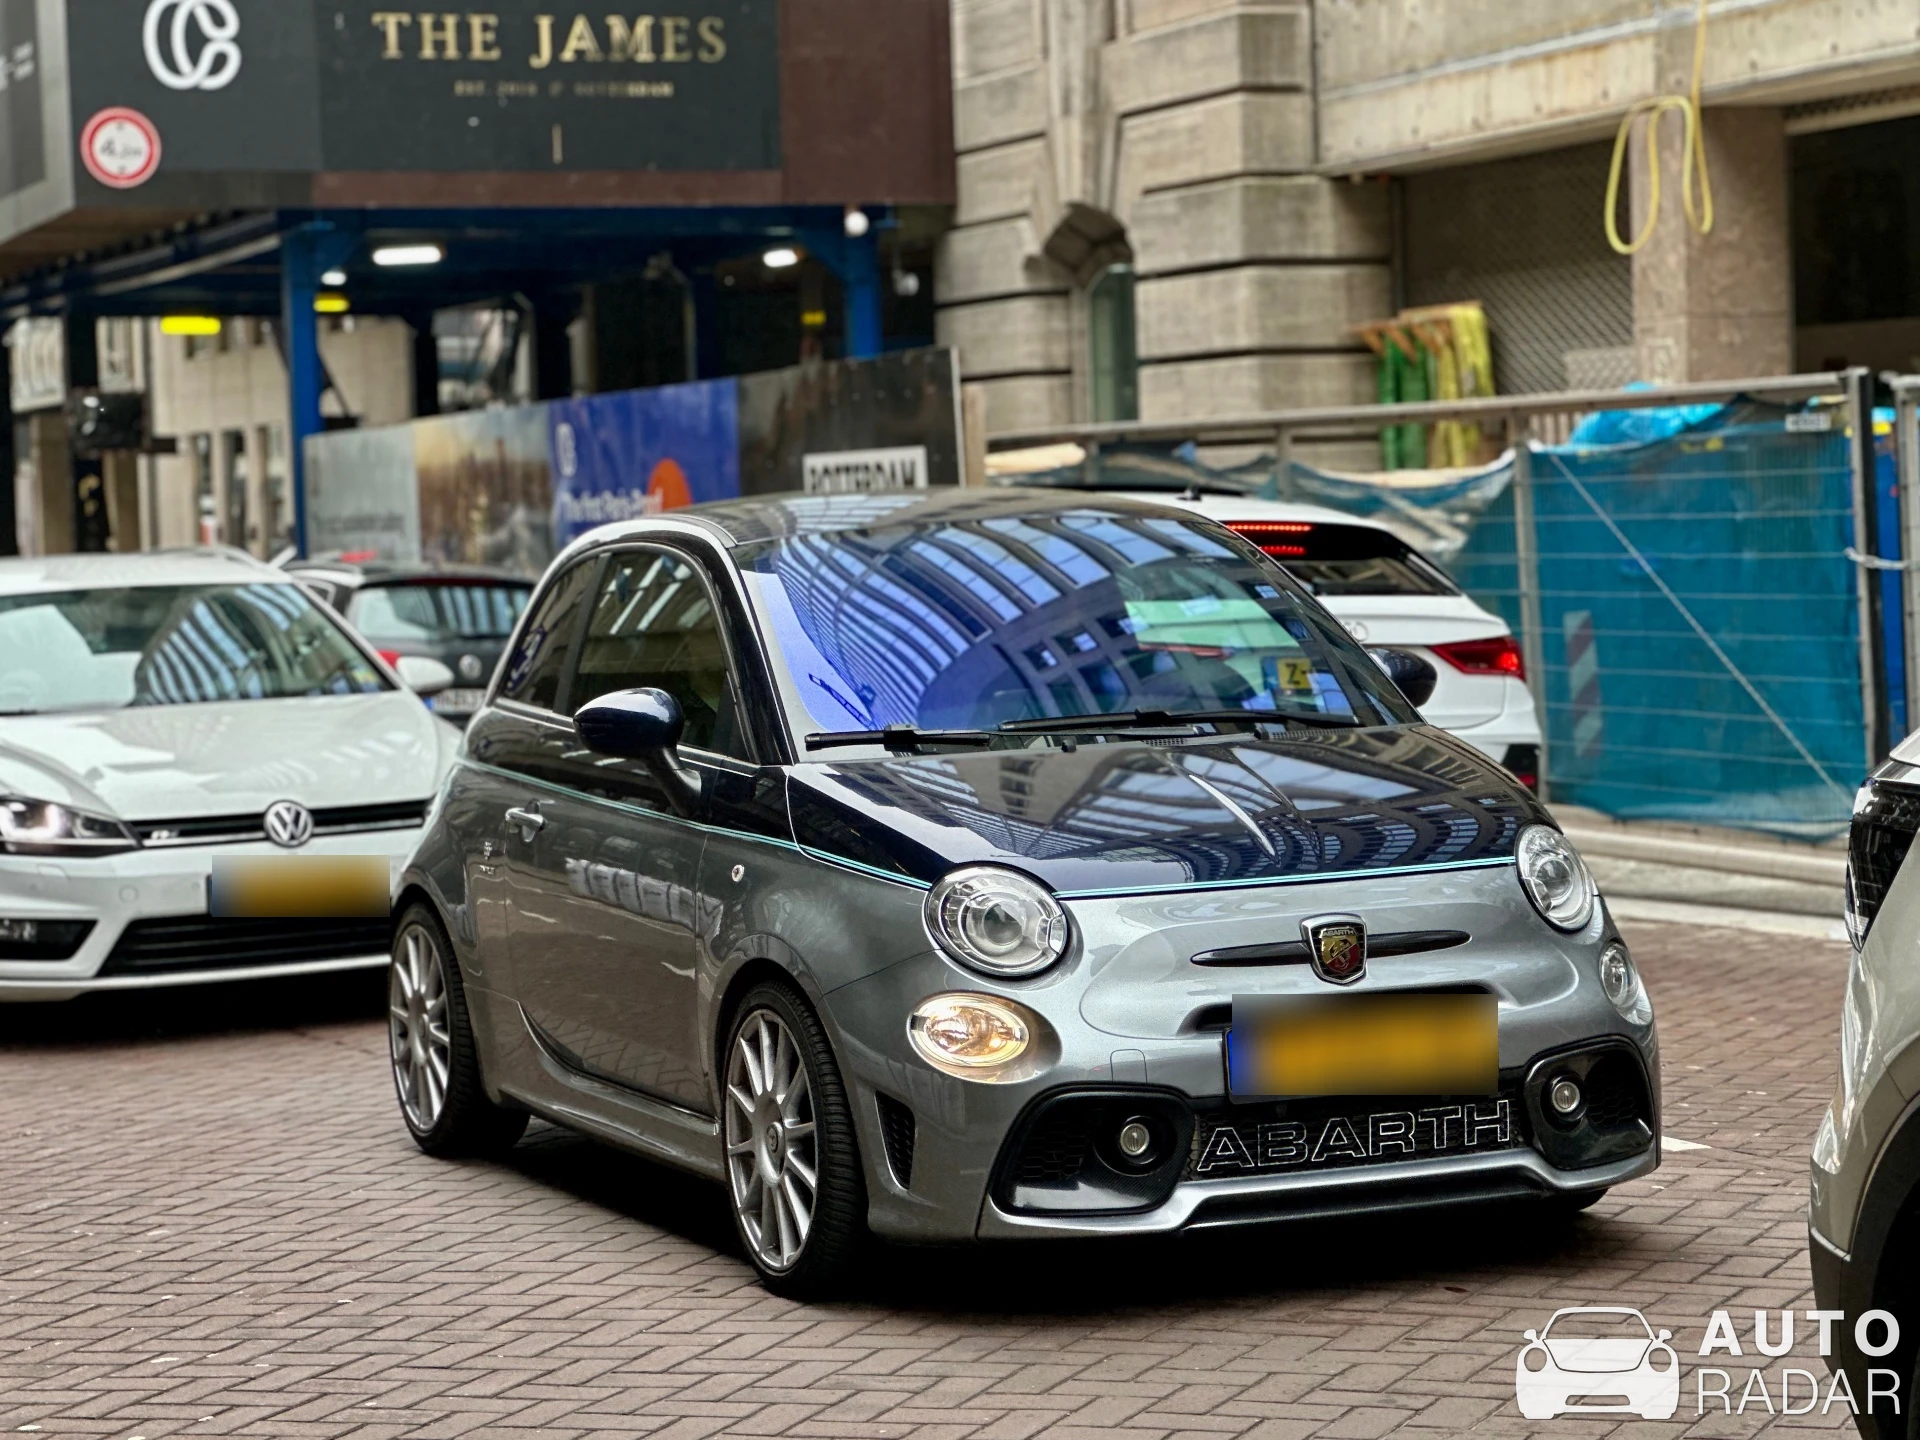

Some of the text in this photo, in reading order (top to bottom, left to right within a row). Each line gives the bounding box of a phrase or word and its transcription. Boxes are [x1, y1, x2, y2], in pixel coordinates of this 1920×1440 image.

[371, 12, 727, 68] THE JAMES
[1323, 929, 1355, 937] ABARTH
[1197, 1100, 1510, 1171] ABARTH
